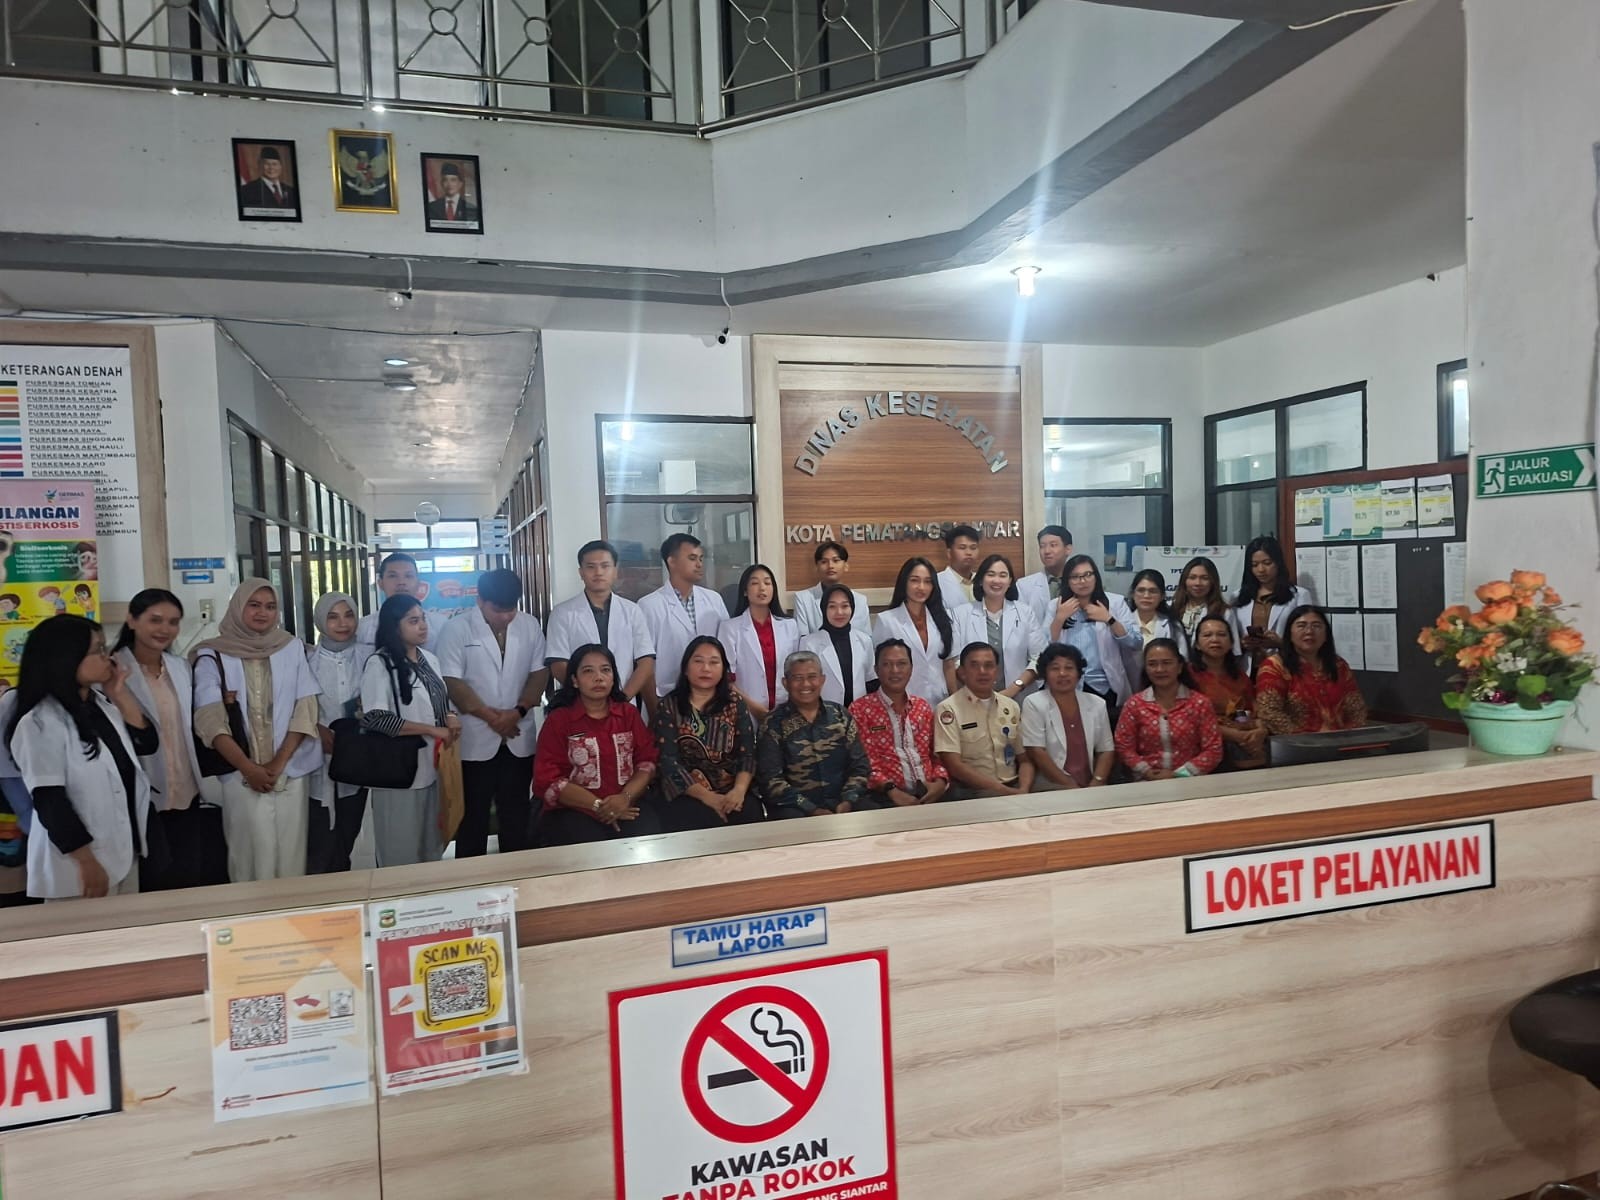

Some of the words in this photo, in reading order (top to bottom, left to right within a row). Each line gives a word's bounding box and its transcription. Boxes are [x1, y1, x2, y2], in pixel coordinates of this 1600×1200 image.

[1, 364, 81, 376] KETERANGAN
[83, 366, 123, 377] DENAH
[794, 406, 863, 476] DINAS
[865, 392, 1008, 473] KESEHATAN
[1508, 457, 1550, 471] JALUR
[1508, 470, 1573, 486] EVAKUASI
[786, 524, 836, 543] KOTA
[1205, 859, 1304, 914] LOKET
[1313, 835, 1481, 899] PELAYANAN
[683, 925, 741, 945] TAMU
[748, 912, 816, 935] HARAP
[423, 944, 460, 964] SCAN
[465, 941, 488, 956] ME
[718, 933, 784, 957] LAPOR
[0, 1035, 96, 1108] AN
[691, 1137, 828, 1186] KAWASAN
[661, 1178, 757, 1200] ANPA
[763, 1155, 856, 1195] ROKOK
[839, 1181, 888, 1199] SIANTAR
